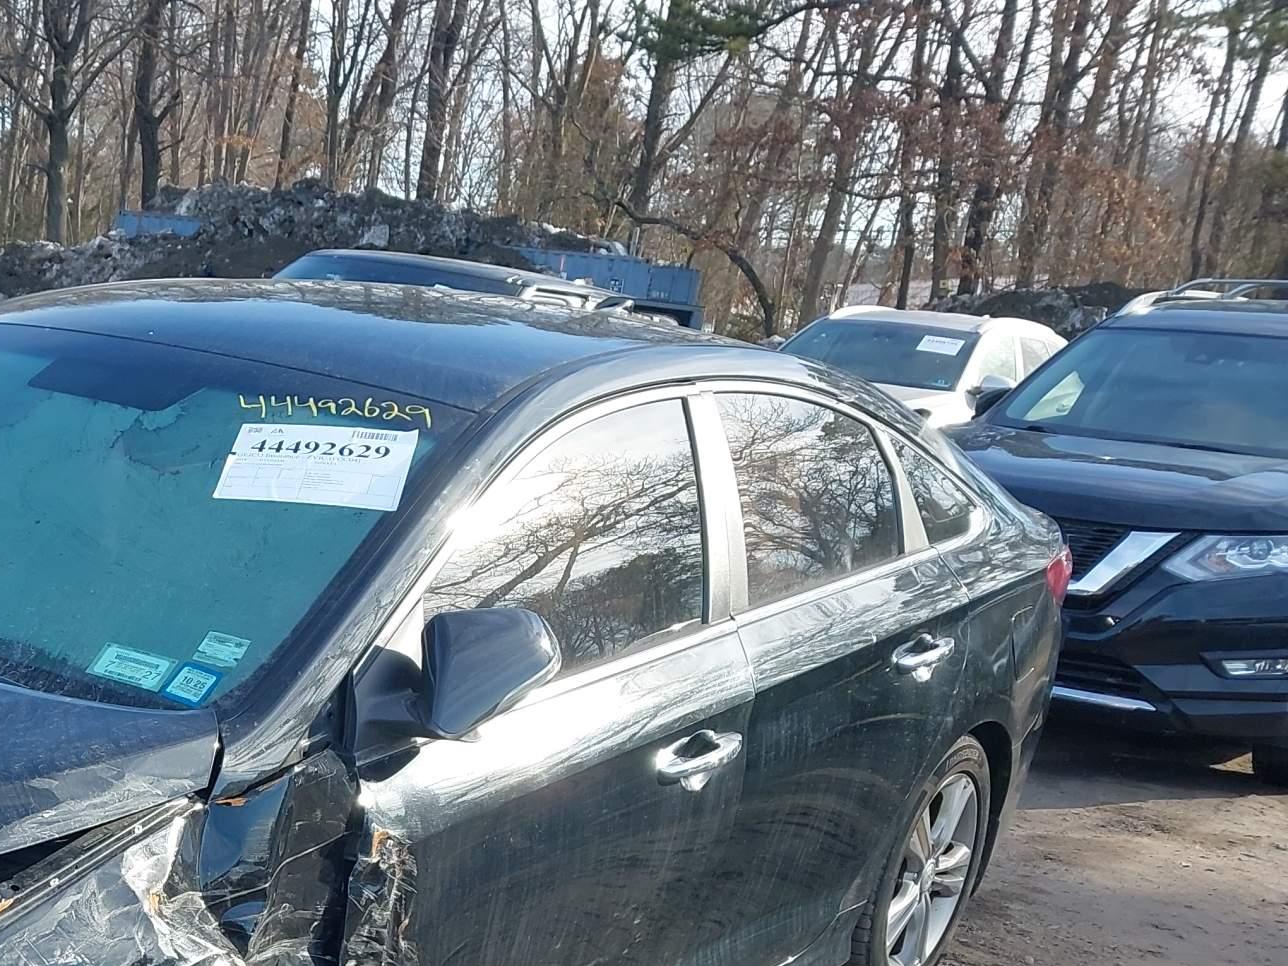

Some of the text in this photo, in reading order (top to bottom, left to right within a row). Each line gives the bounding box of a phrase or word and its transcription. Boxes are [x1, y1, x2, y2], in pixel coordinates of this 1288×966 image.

[239, 394, 432, 429] 44492629
[251, 439, 390, 460] 44492629
[143, 670, 162, 681] 27
